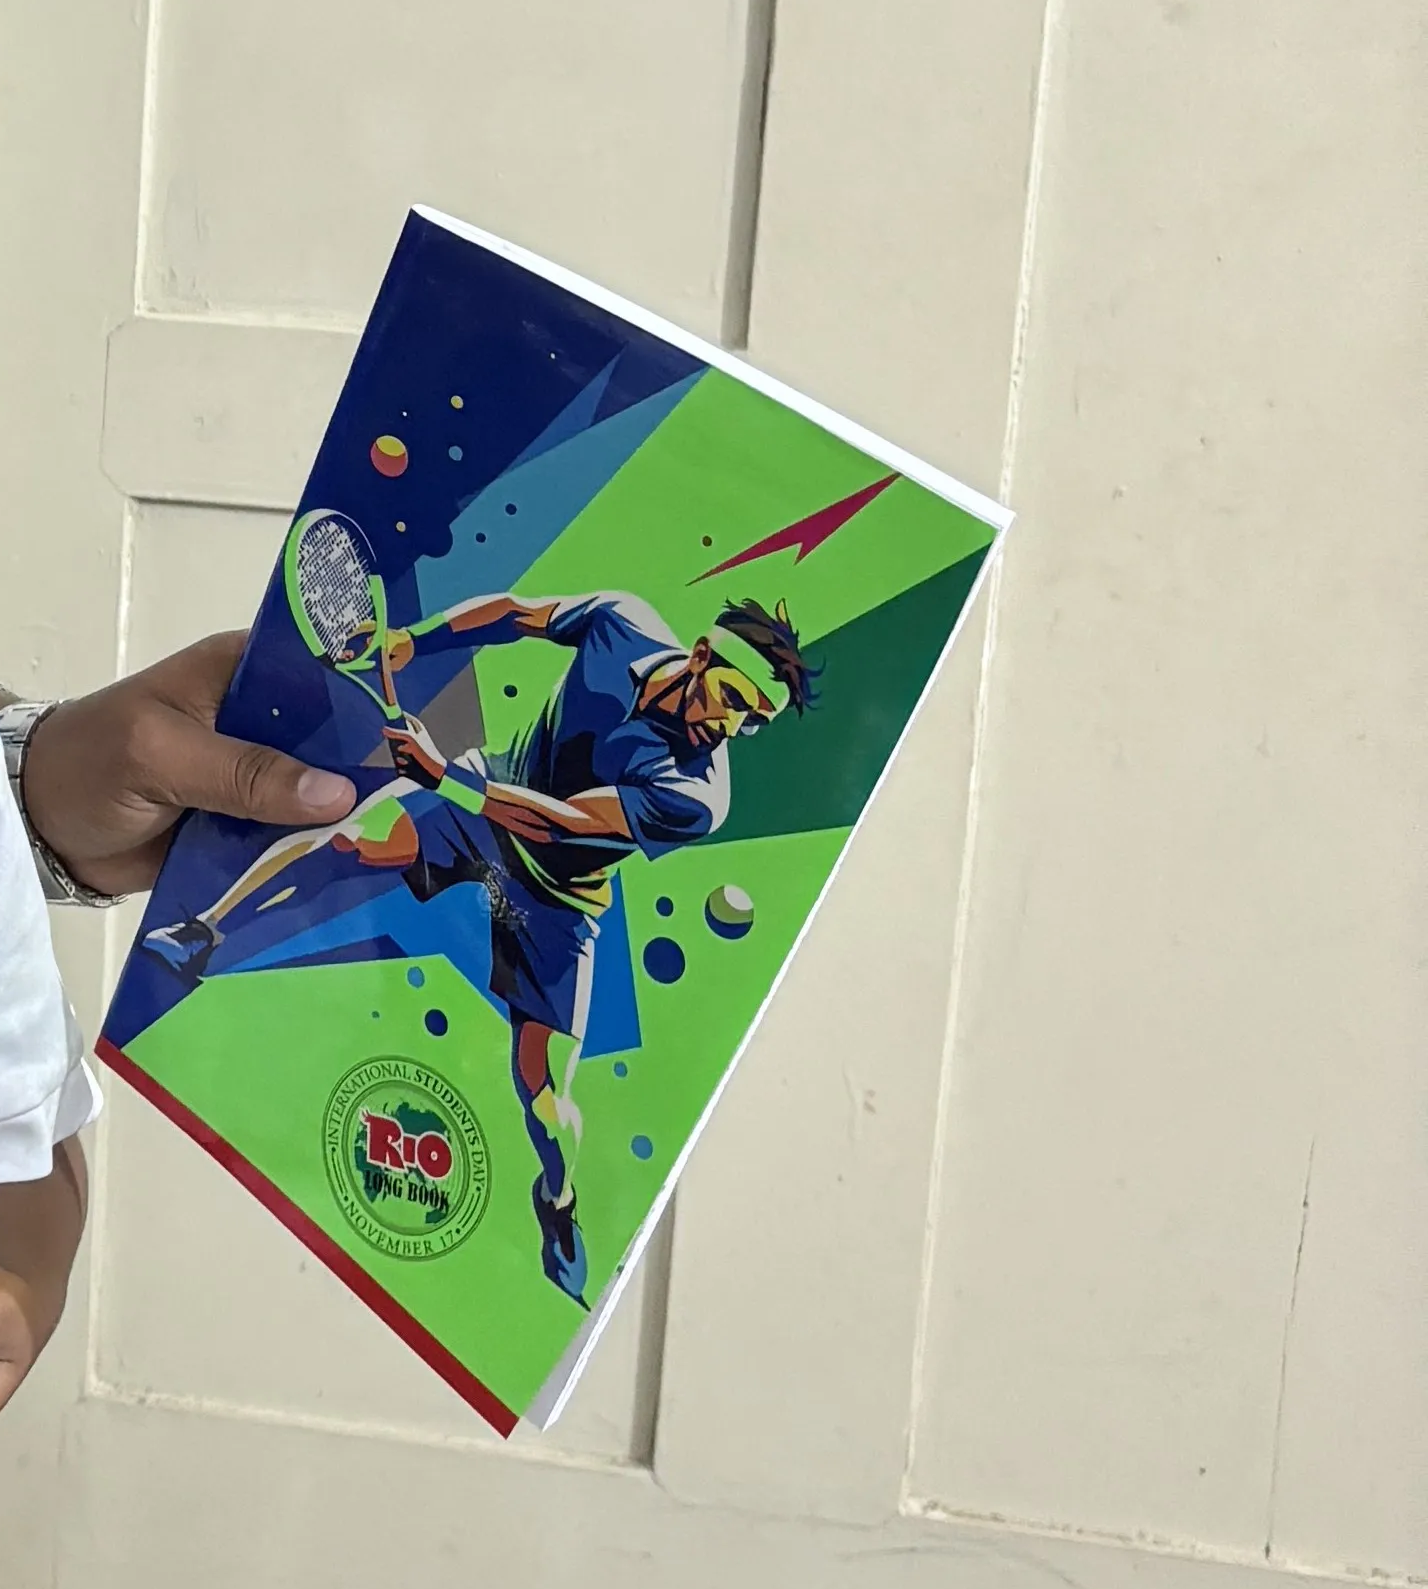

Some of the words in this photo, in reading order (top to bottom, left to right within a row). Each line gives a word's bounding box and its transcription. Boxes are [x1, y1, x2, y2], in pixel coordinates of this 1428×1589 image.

[328, 1063, 411, 1147] INTERNATIONAL
[472, 1150, 486, 1188] DAY
[364, 1169, 404, 1200] LONG
[407, 1180, 451, 1211] BOOK
[345, 1202, 434, 1256] NOVEMBER
[439, 1229, 456, 1248] 17
